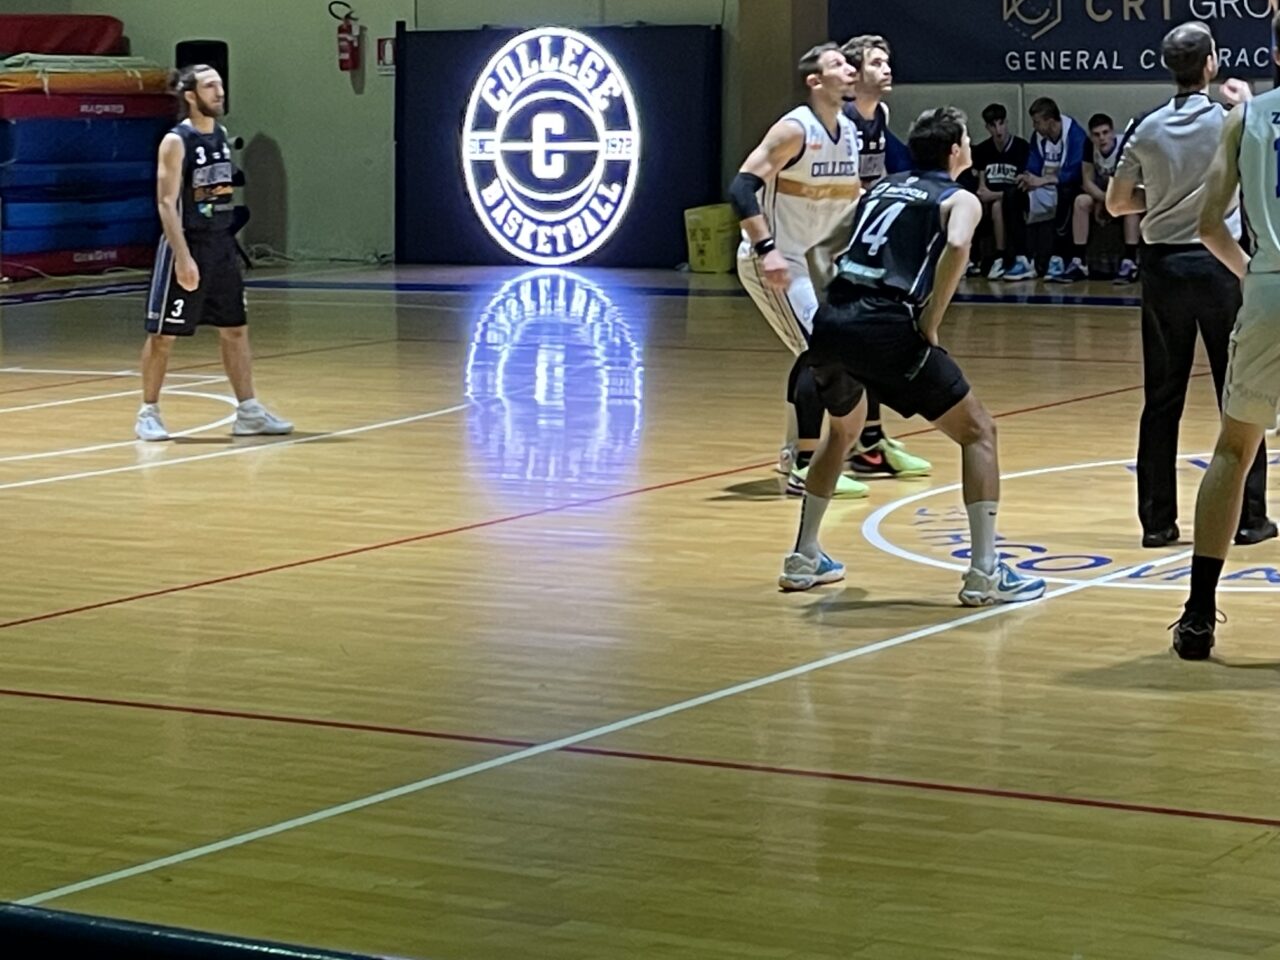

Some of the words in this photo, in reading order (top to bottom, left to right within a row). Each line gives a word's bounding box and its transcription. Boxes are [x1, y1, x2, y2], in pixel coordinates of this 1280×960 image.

[480, 35, 623, 113] COLLEGE
[1005, 49, 1124, 72] GENERAL
[195, 146, 207, 165] 3
[532, 112, 565, 179] C
[480, 177, 622, 254] BASKETBALL
[848, 199, 908, 256] 14
[171, 298, 184, 318] 3
